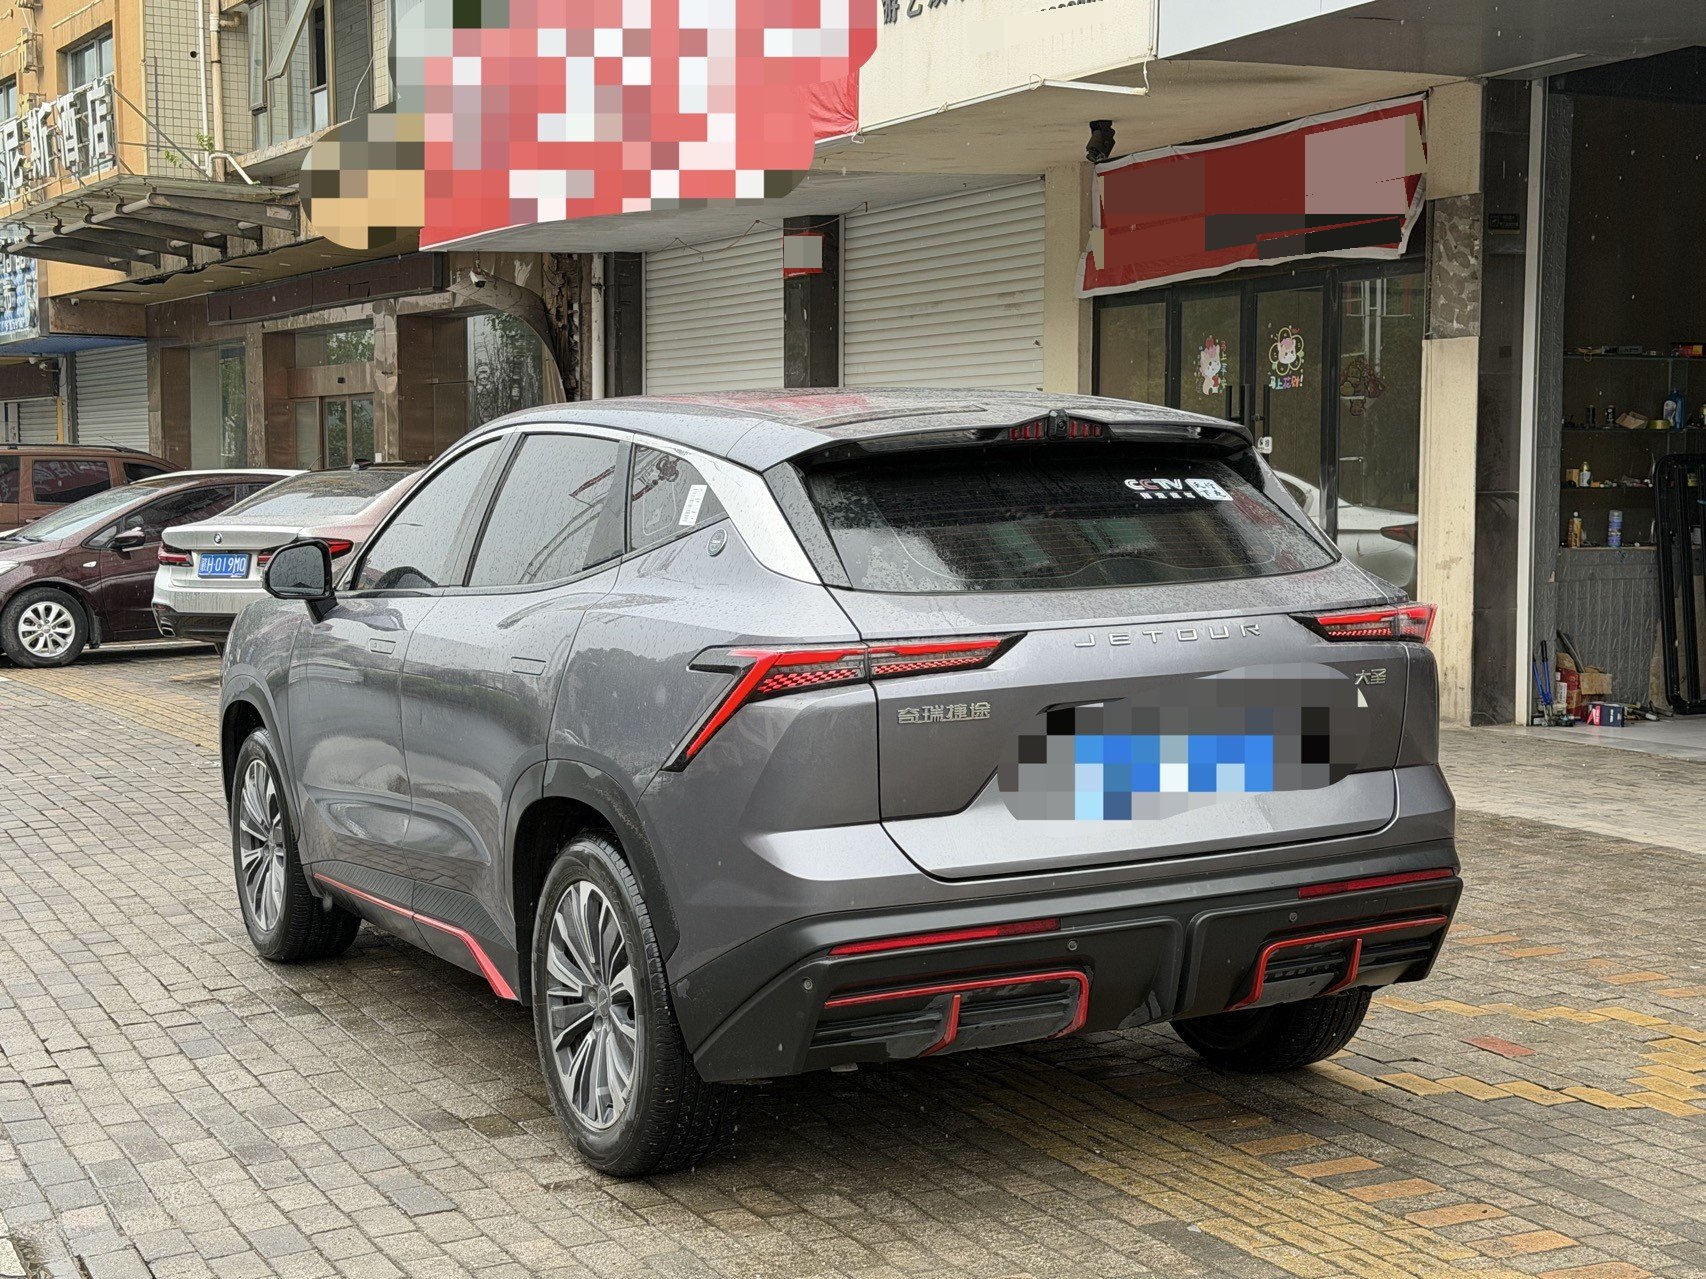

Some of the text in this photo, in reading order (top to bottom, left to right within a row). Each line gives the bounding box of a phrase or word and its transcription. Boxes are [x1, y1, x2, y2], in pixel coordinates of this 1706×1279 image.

[2, 79, 108, 188] 尼斯酒店
[1124, 478, 1183, 490] CCTV
[1074, 623, 1262, 648] JETOUR
[1354, 668, 1387, 685] 大圣
[897, 701, 991, 724] 奇瑞捷途
